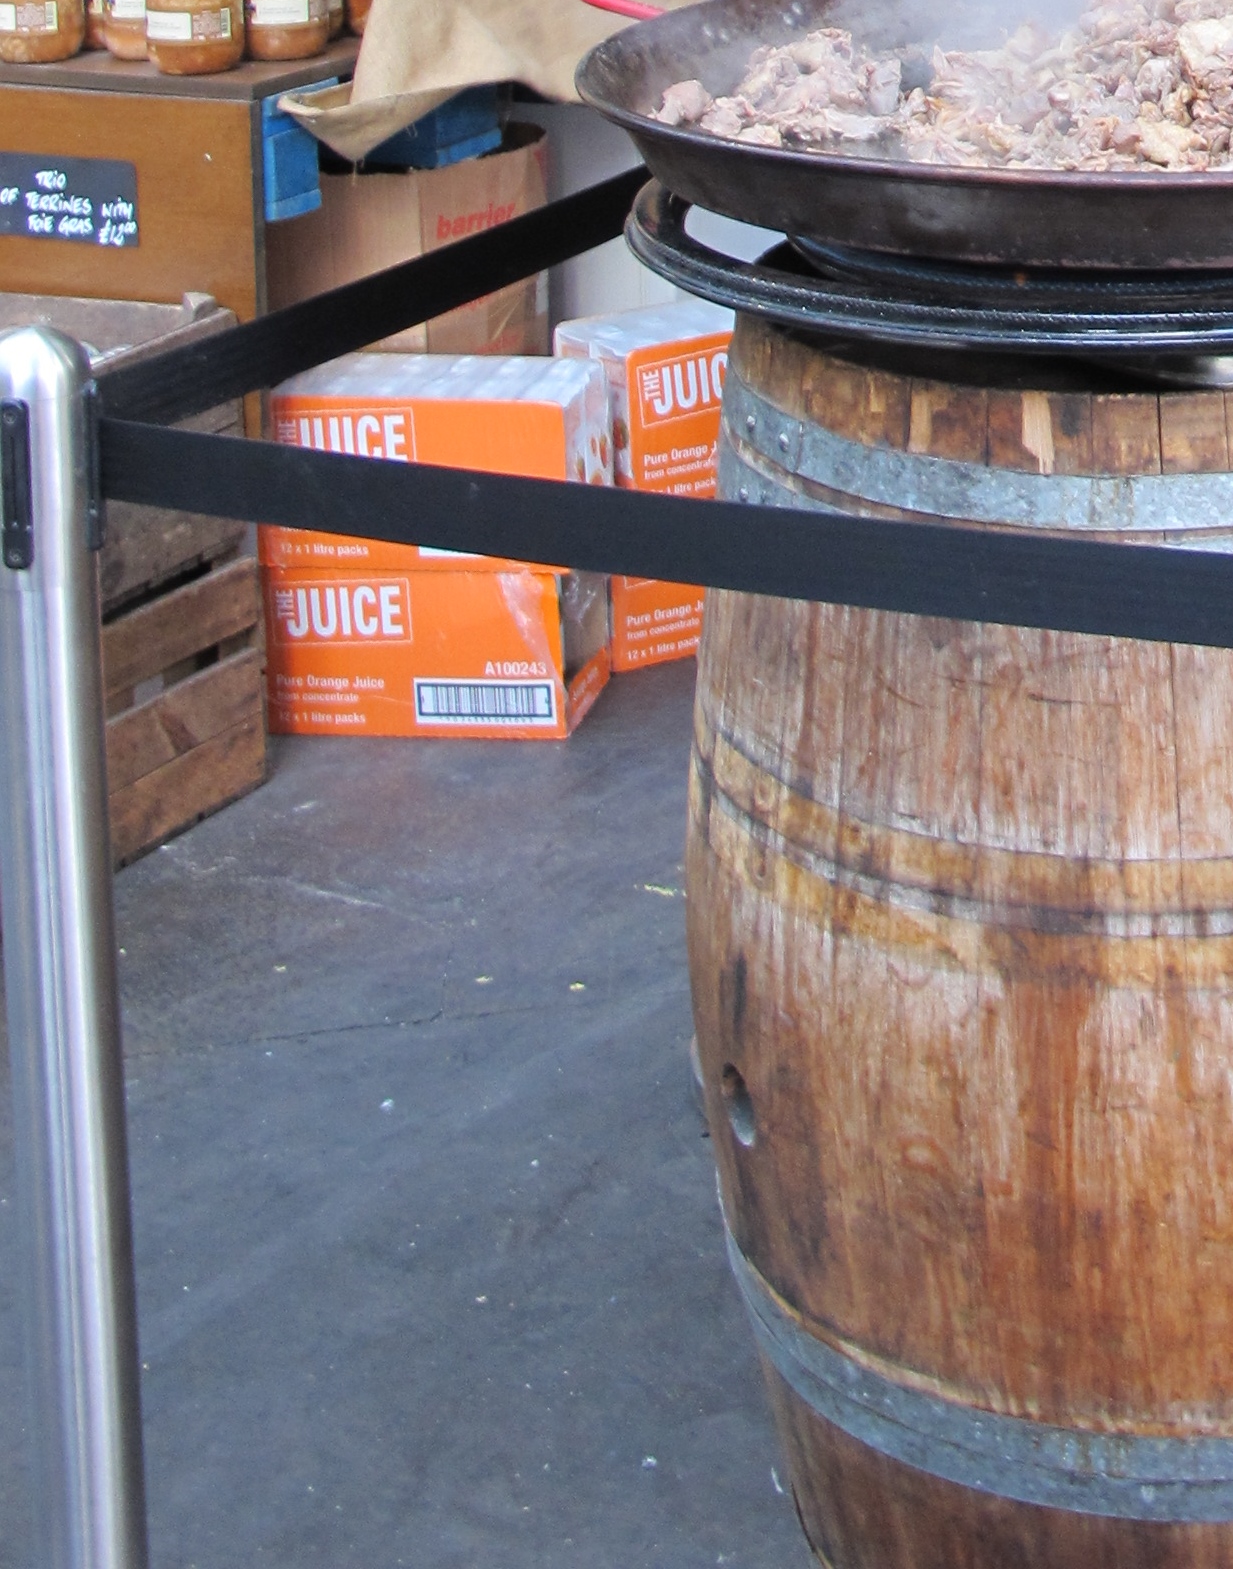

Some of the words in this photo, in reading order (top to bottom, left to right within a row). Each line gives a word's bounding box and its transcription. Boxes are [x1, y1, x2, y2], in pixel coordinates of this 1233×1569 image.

[0, 187, 19, 206] OF
[57, 214, 94, 237] GRAS
[642, 368, 662, 401] THE
[653, 352, 729, 416] JUIC
[643, 451, 668, 467] Pure
[670, 442, 709, 462] Orange
[643, 467, 666, 481] from
[694, 476, 717, 493] pack
[313, 542, 336, 555] litre
[337, 544, 370, 558] packs
[276, 588, 295, 620] THE
[286, 584, 405, 639] JUICE
[626, 613, 652, 628] Pure
[653, 603, 692, 621] Orange
[627, 649, 639, 662] 12
[657, 640, 676, 654] litre
[677, 635, 701, 650] pack
[484, 660, 548, 677] A100243
[276, 673, 304, 688] Pure
[306, 674, 350, 691] Orange
[353, 675, 386, 690] Juice
[302, 692, 360, 703] concentrate
[311, 711, 333, 724] litre
[334, 712, 367, 726] packs
